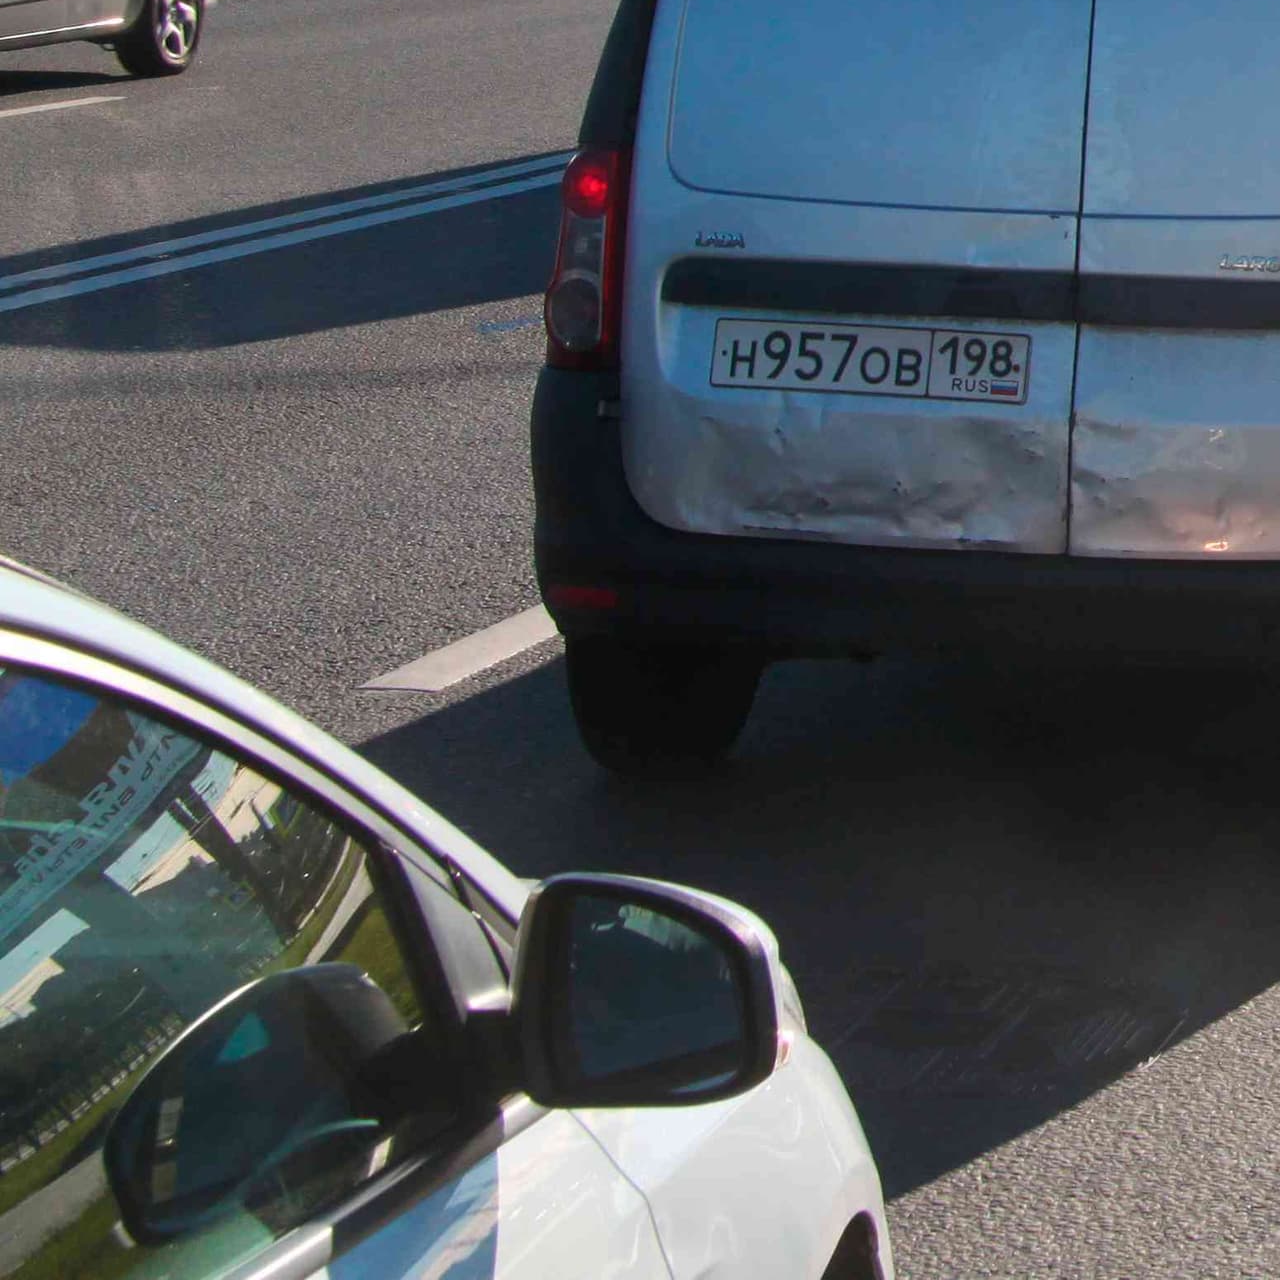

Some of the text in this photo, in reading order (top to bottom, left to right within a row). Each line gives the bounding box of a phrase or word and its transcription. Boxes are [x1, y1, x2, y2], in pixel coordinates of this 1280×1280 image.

[695, 231, 746, 249] LADA
[729, 329, 923, 387] Н957ОВ
[938, 335, 1014, 378] 198
[951, 376, 990, 394] RUS
